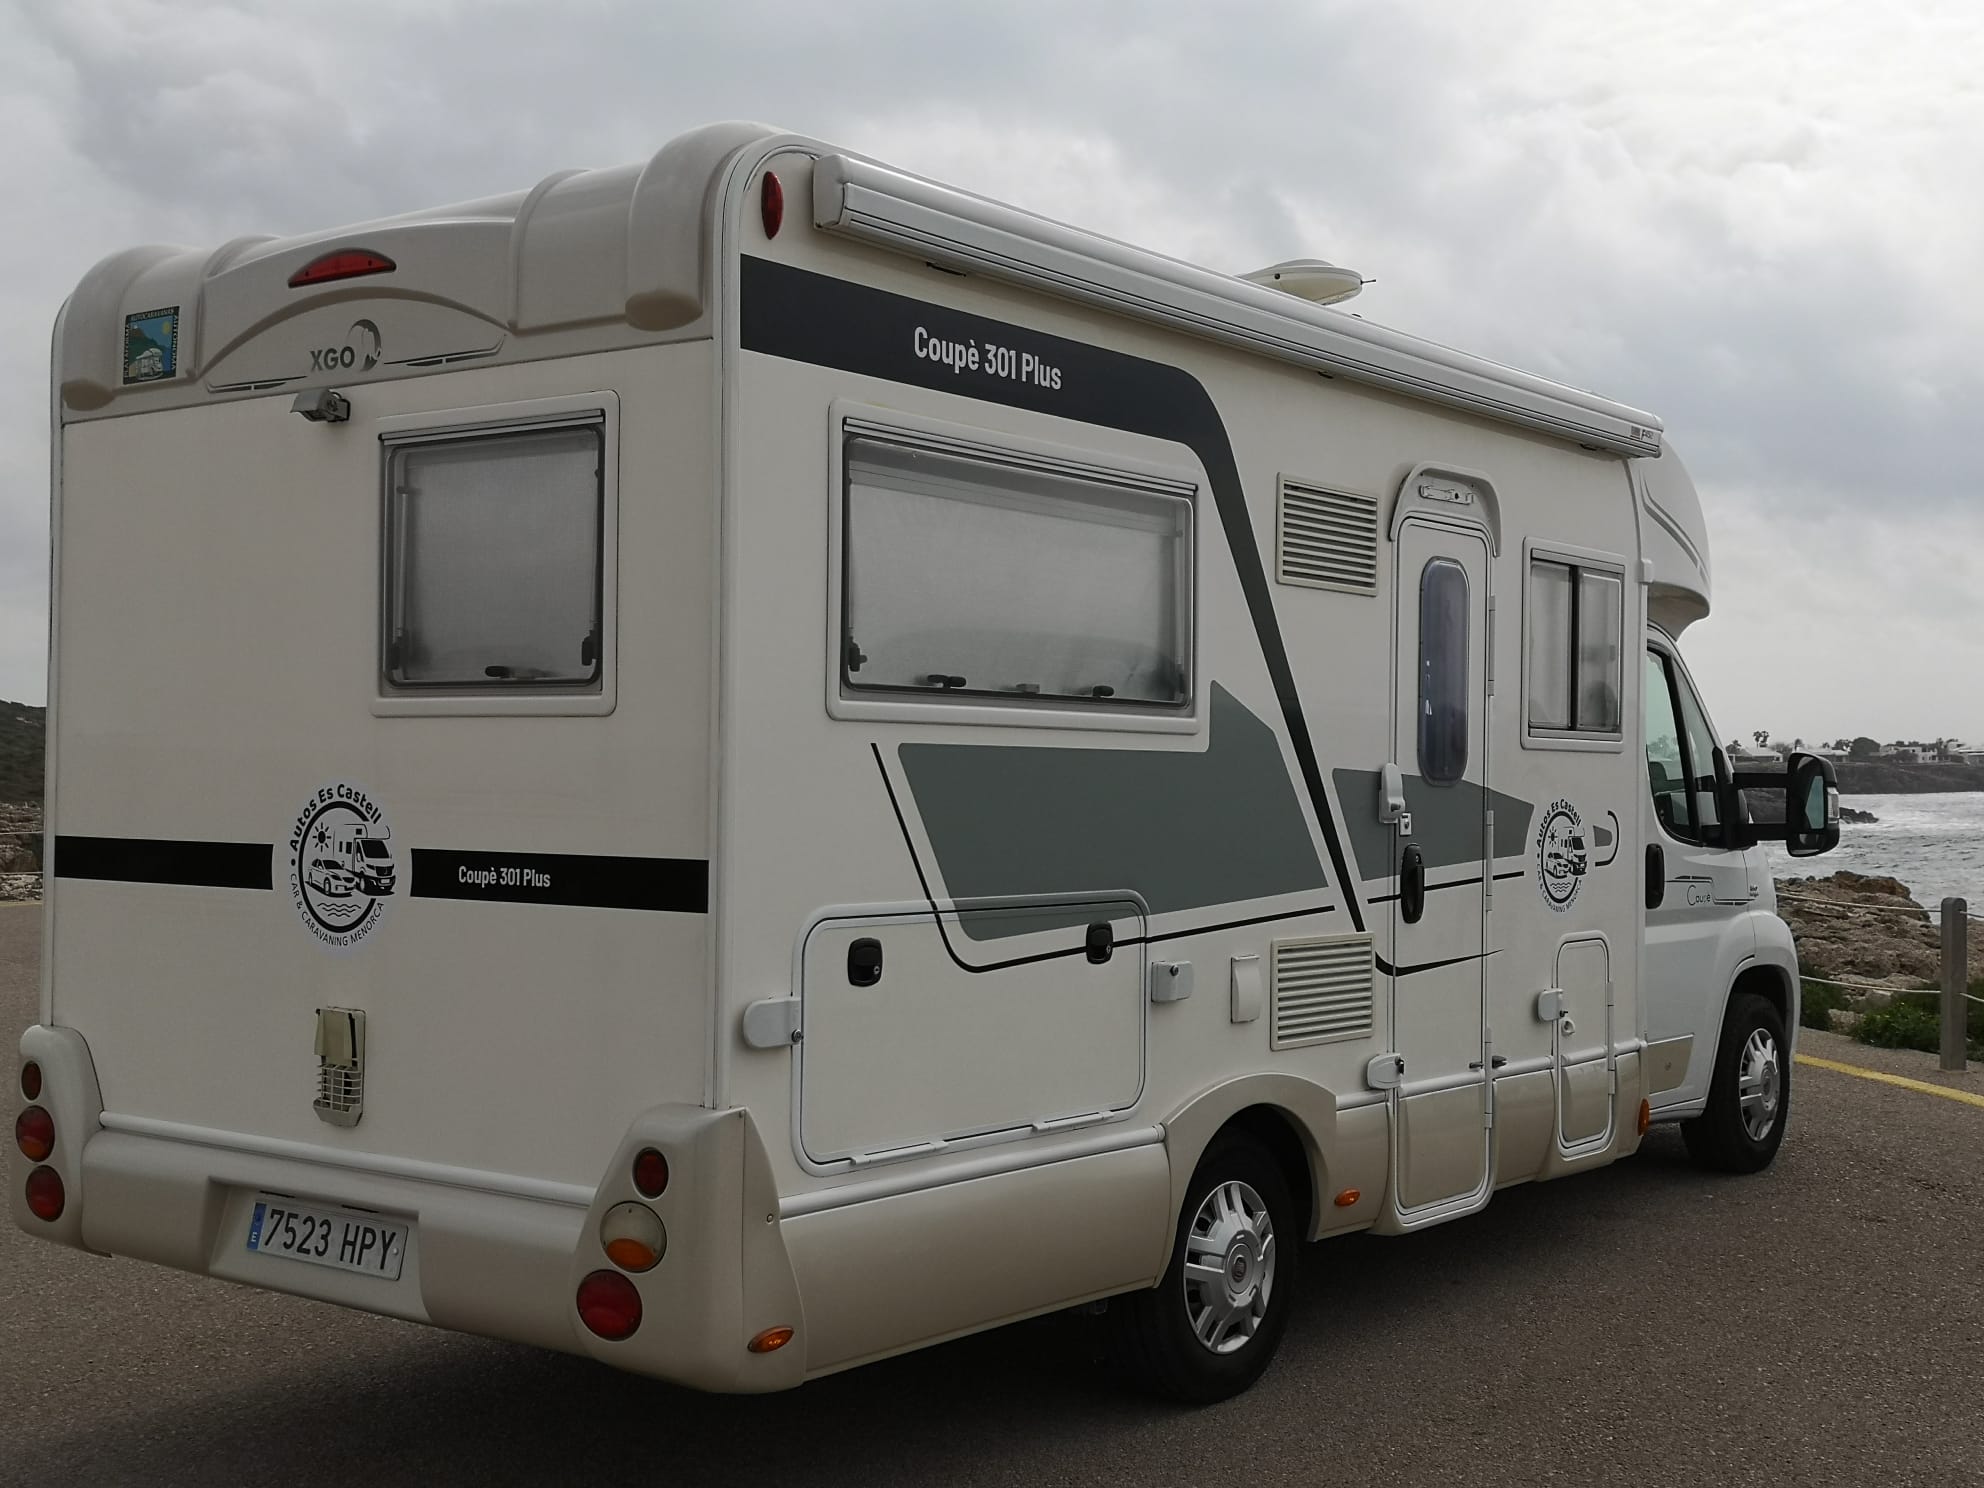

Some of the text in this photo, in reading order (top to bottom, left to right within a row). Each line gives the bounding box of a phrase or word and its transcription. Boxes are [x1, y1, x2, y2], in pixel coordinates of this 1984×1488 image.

[310, 346, 355, 372] XGO
[914, 326, 1062, 390] Coupè 301 Plus
[289, 784, 382, 852] Autos Es Castell
[1536, 810, 1551, 848] Autos
[458, 865, 551, 888] Coupè 301 Plus
[290, 873, 300, 898] CAR
[301, 911, 349, 947] CARAVANING
[350, 902, 385, 944] MENORCA
[265, 1208, 396, 1270] 7523 HPY
